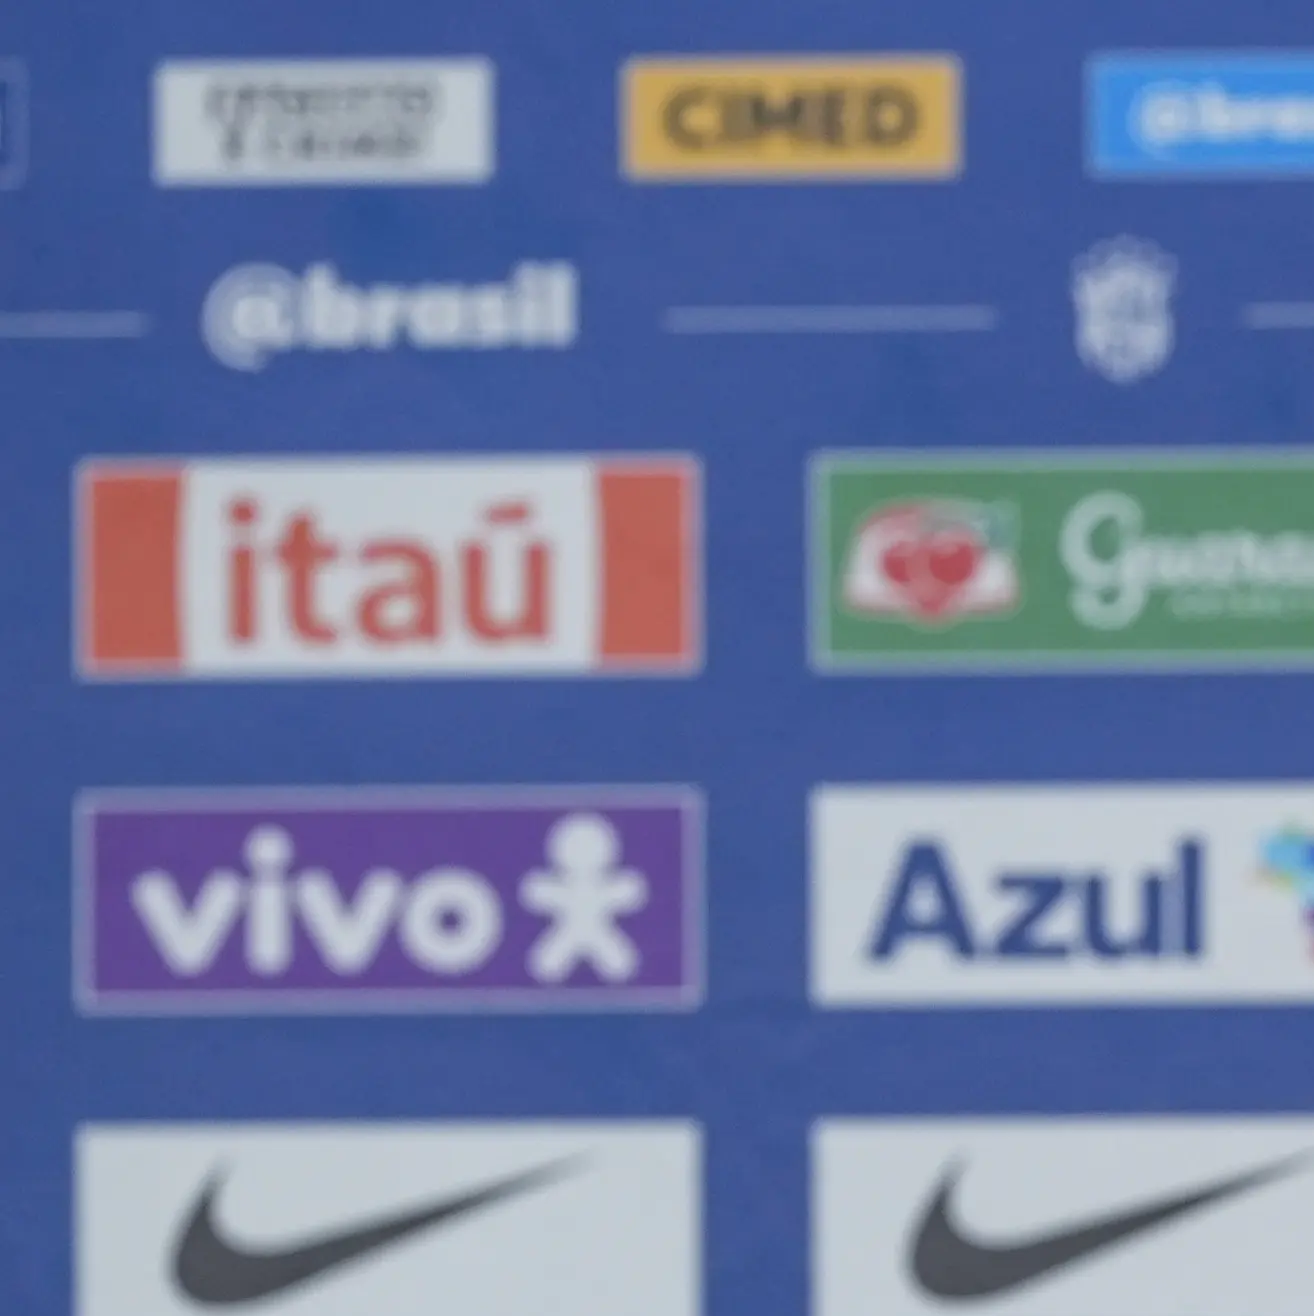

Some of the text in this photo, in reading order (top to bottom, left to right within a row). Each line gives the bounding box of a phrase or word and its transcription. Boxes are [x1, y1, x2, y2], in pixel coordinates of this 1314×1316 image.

[662, 85, 920, 152] CIMED
[205, 264, 576, 366] @brasil
[227, 497, 550, 645] itaú
[134, 829, 501, 973] vivo
[868, 838, 1204, 962] Azul
